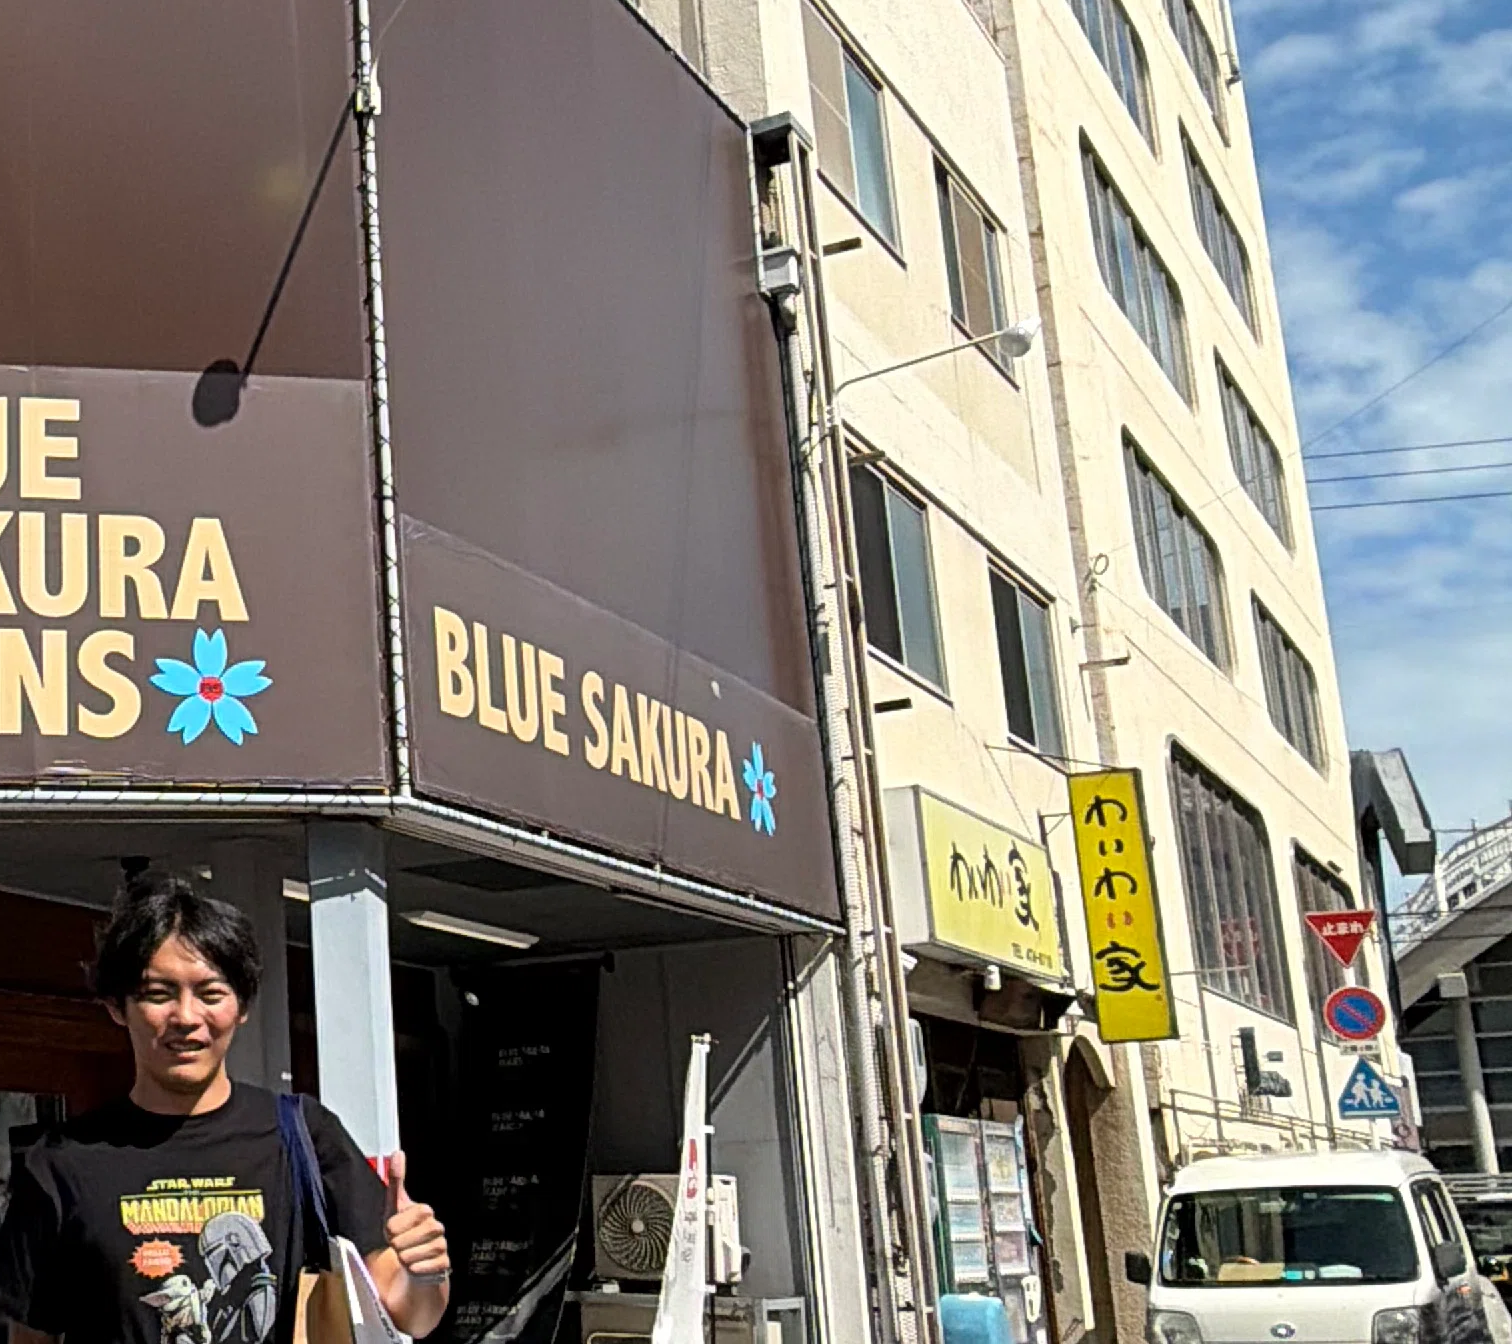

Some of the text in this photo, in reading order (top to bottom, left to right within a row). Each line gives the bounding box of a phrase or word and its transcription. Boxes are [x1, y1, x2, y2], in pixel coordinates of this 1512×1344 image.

[434, 606, 742, 821] BLUE SAKURA
[1084, 794, 1161, 992] わいわい家
[1321, 920, 1365, 936] 止まれ
[146, 1176, 236, 1191] STAR WARS
[120, 1194, 264, 1229] MANDALORIAN
